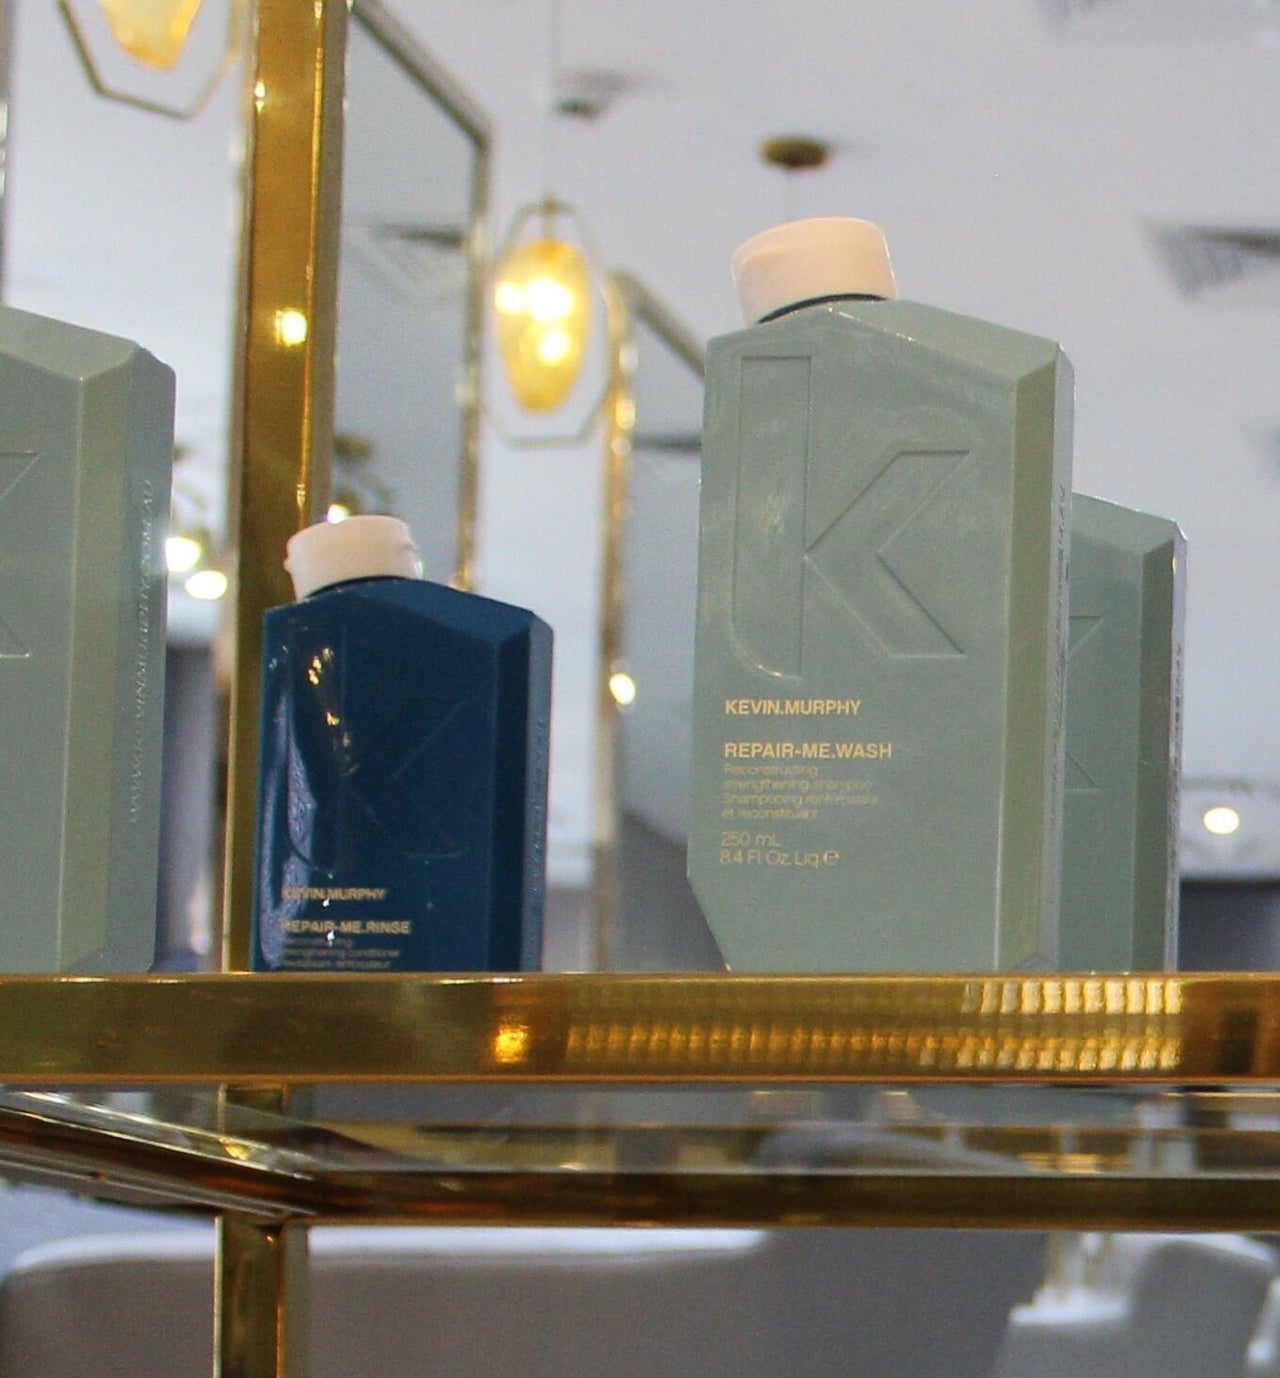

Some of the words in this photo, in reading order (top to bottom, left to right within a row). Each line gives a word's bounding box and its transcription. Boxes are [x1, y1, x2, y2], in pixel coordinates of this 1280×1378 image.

[725, 699, 861, 716] KEVIN.MURPHY
[724, 742, 893, 760] REPAIR-ME.WASH
[720, 831, 751, 848] 250
[755, 832, 780, 848] mL
